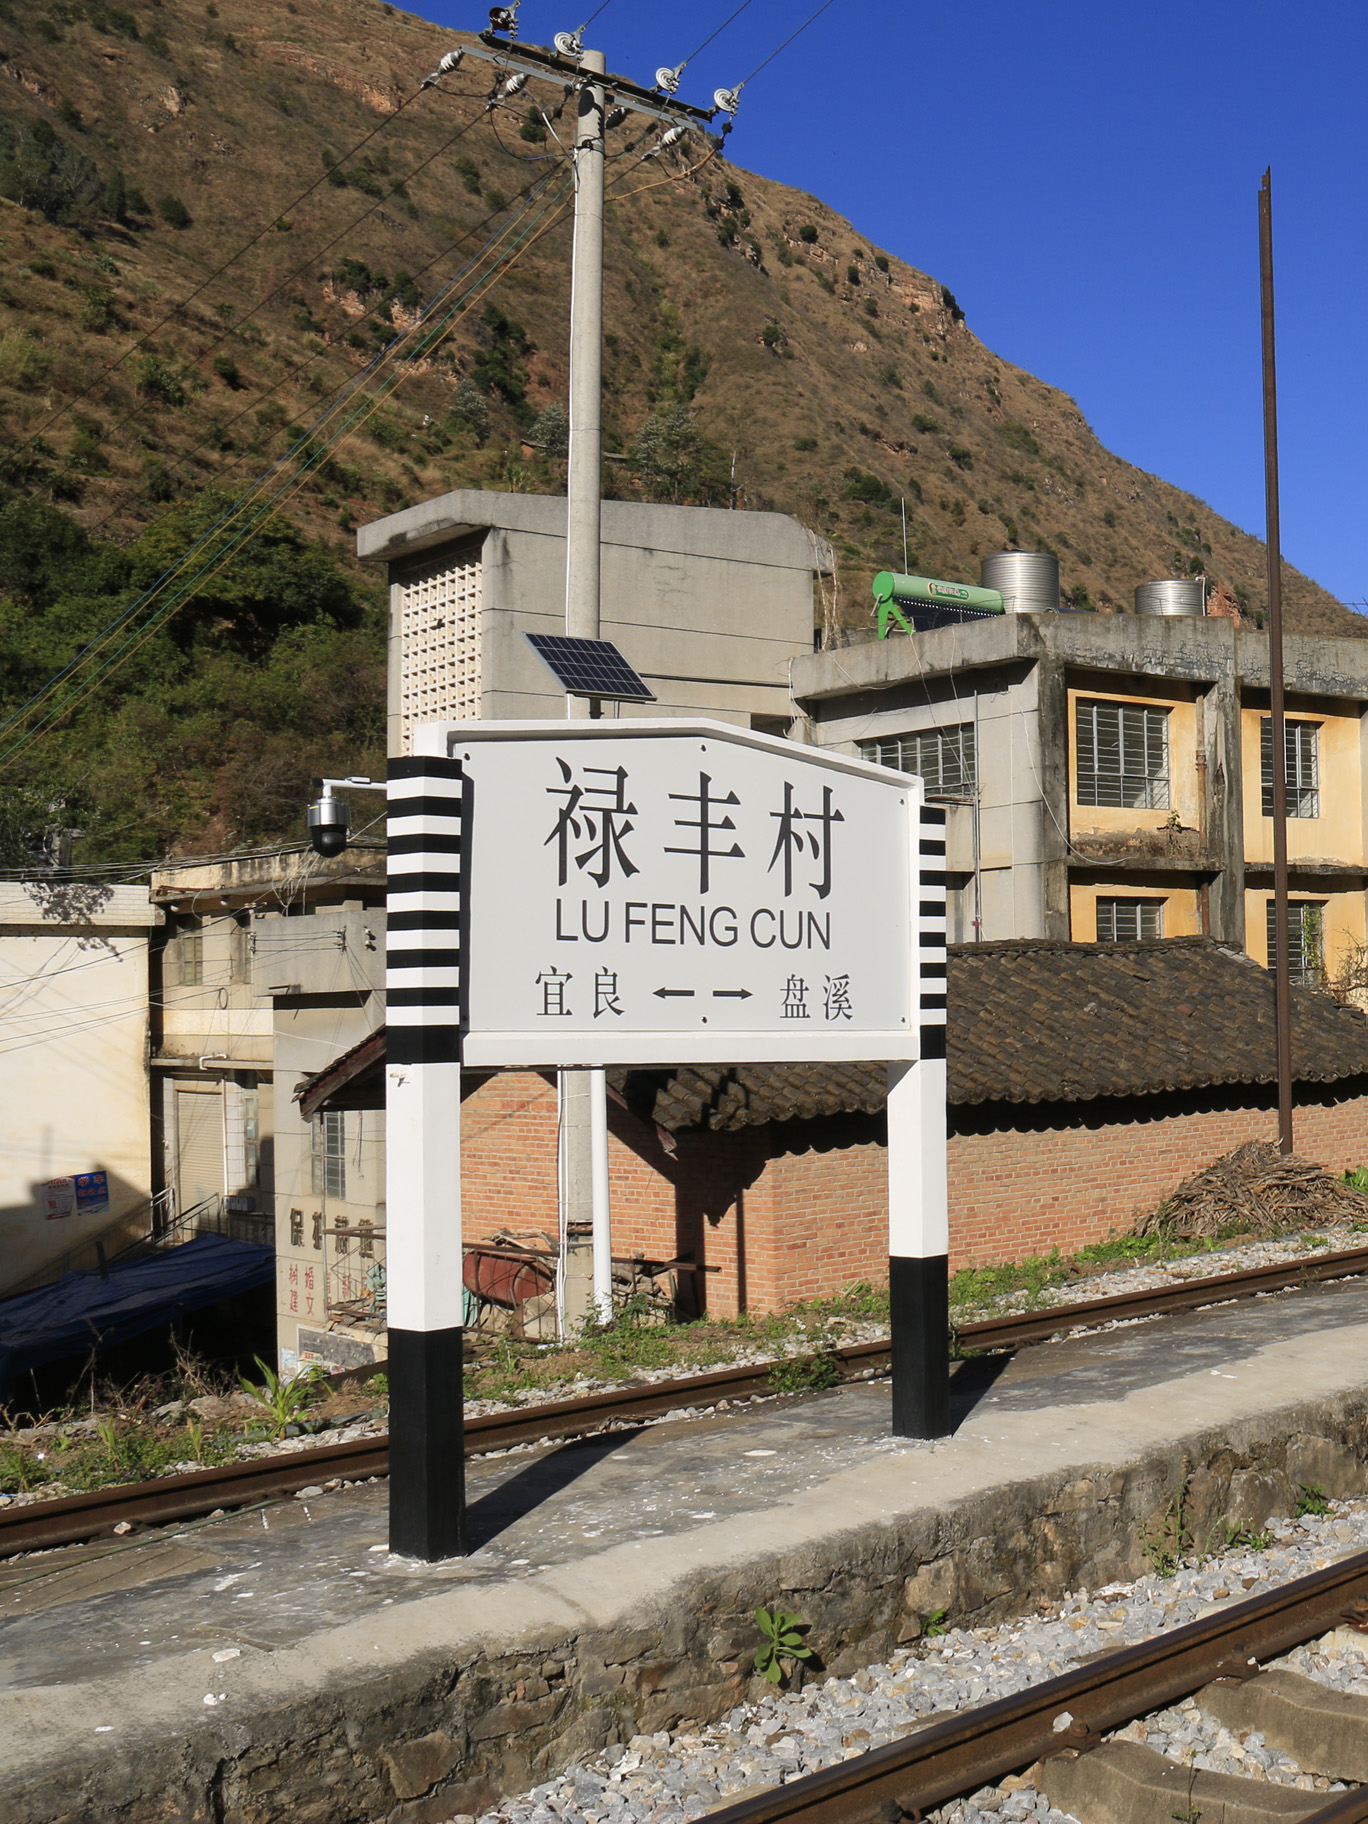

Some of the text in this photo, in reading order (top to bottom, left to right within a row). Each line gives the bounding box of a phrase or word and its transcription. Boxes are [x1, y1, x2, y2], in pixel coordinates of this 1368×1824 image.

[544, 756, 846, 899] 禄丰村
[556, 898, 830, 949] LU FENG CUN
[535, 965, 852, 1020] 宜良 盘溪
